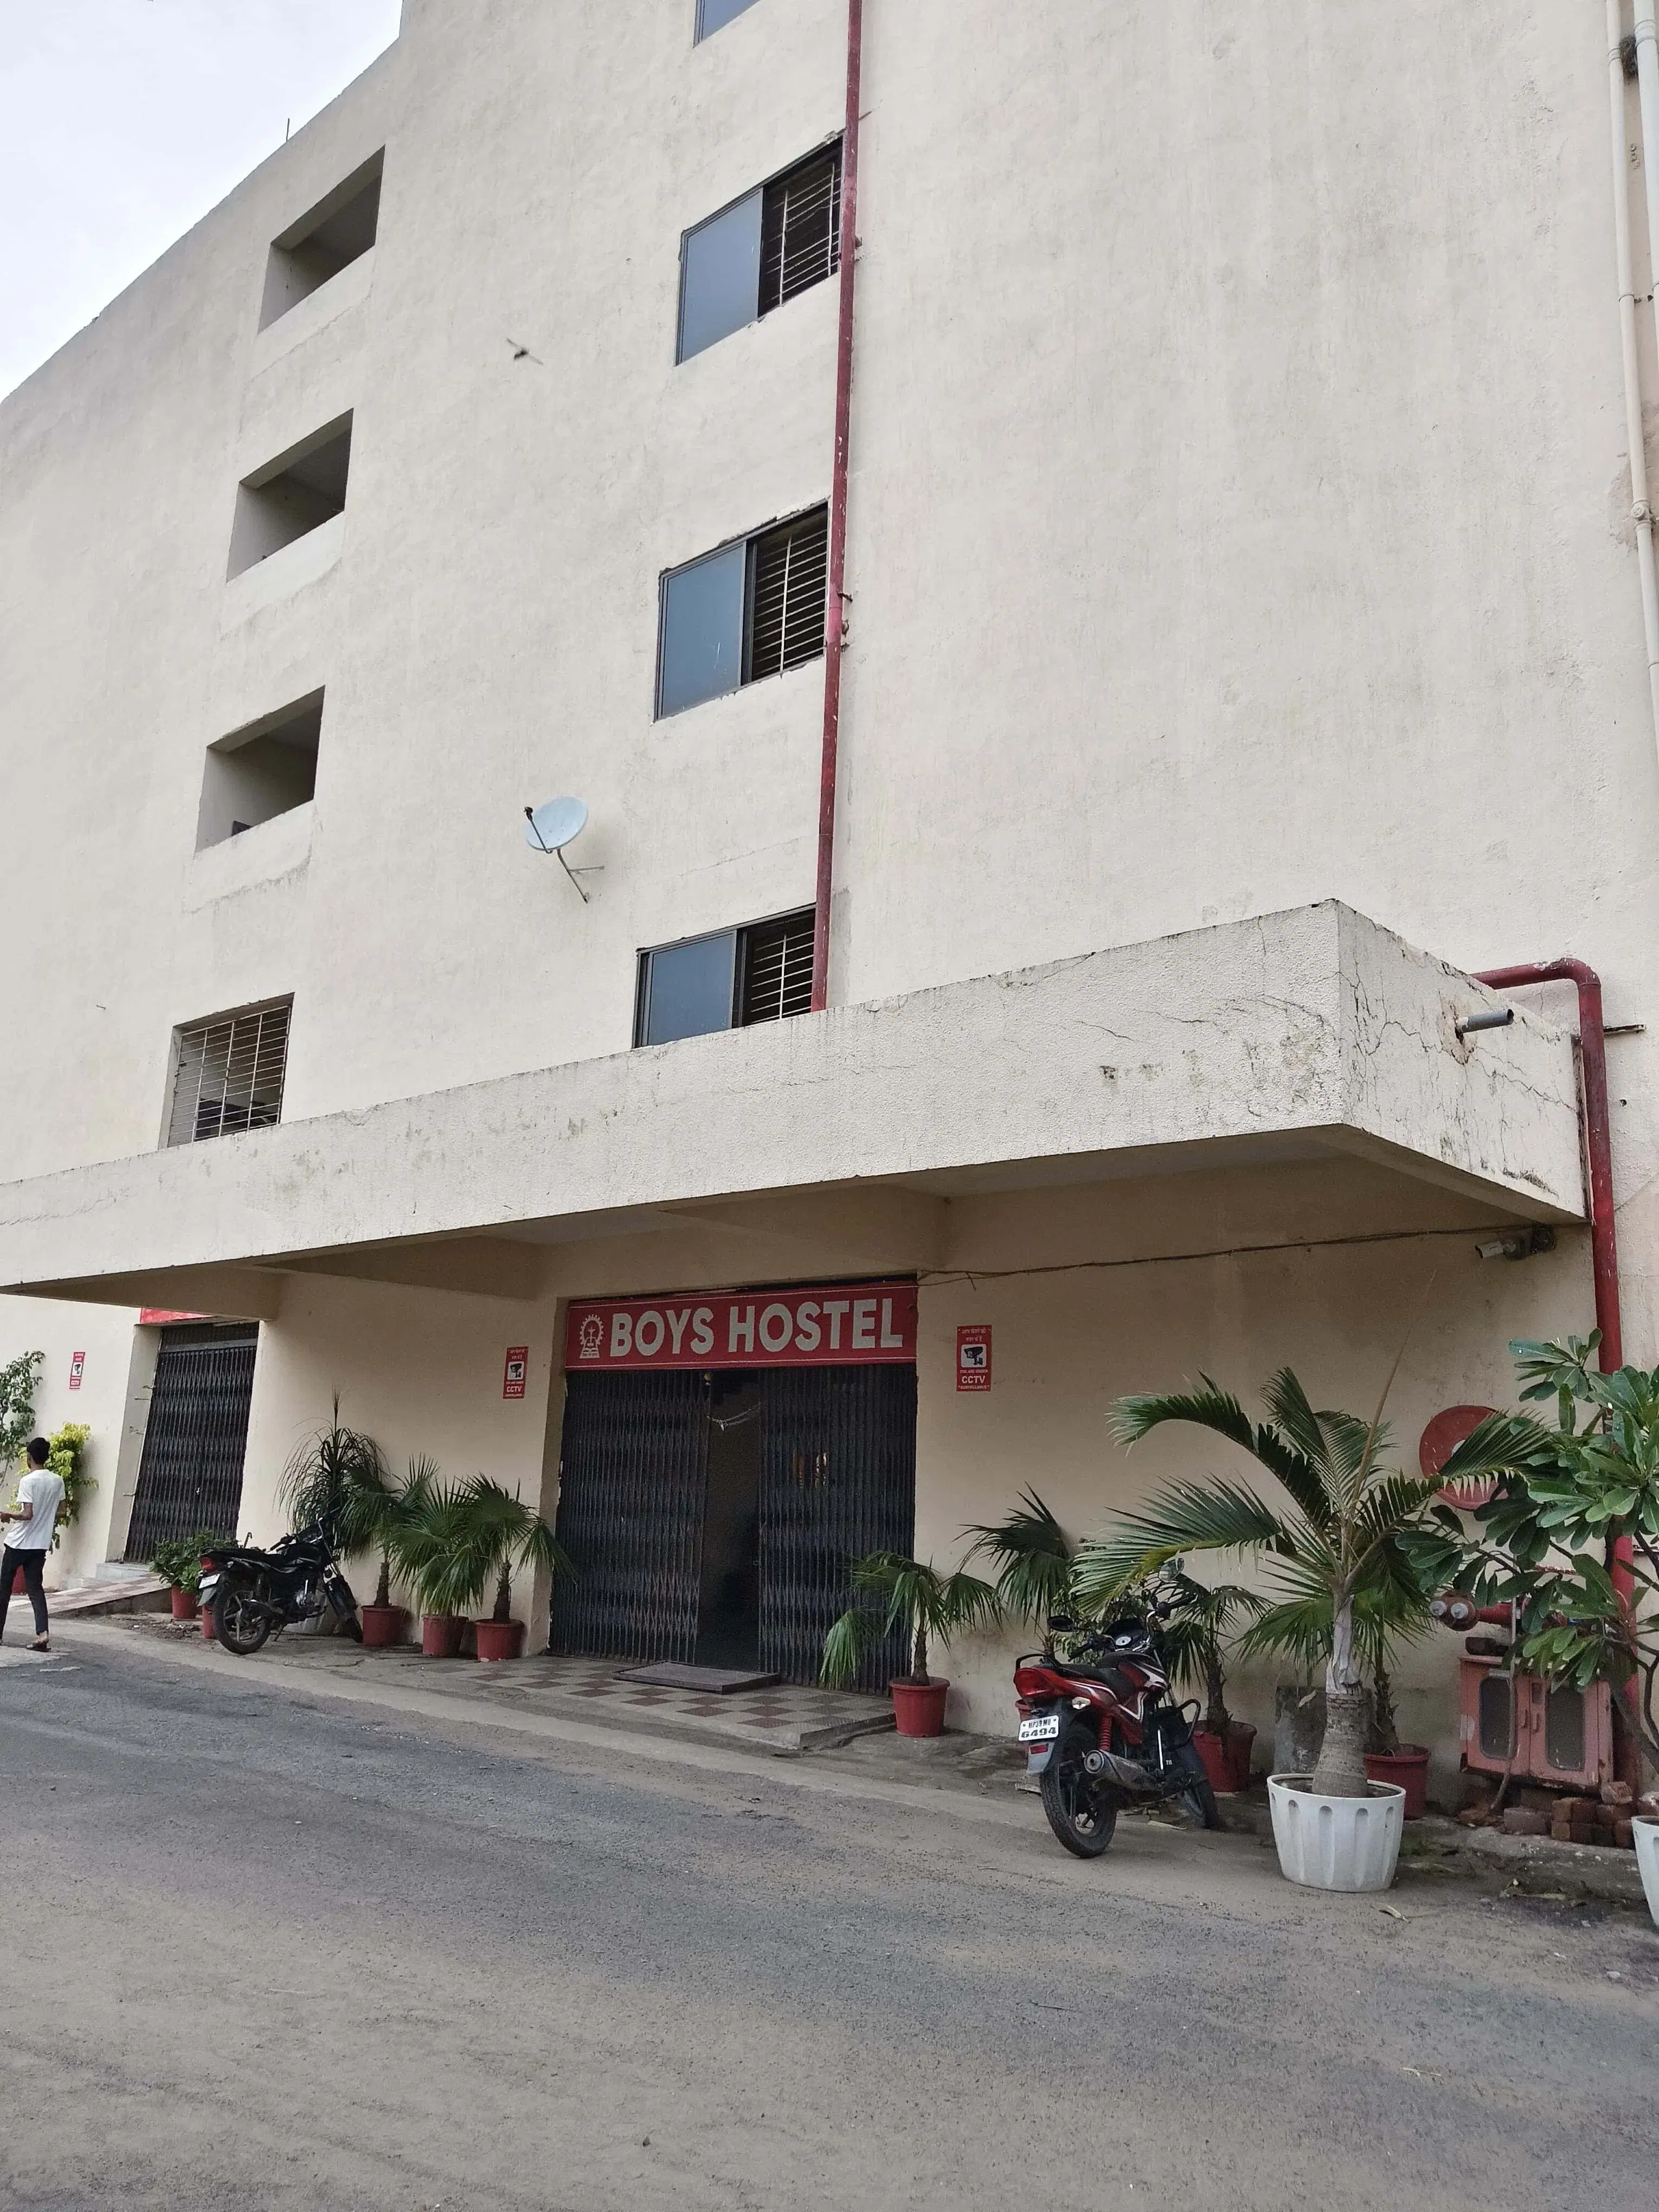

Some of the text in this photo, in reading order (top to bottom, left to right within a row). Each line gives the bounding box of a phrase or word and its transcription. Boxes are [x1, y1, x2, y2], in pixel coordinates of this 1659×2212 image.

[610, 1298, 903, 1358] BOYS HOSTEL
[962, 1375, 986, 1384] CCTV
[1021, 1727, 1057, 1738] 6494
